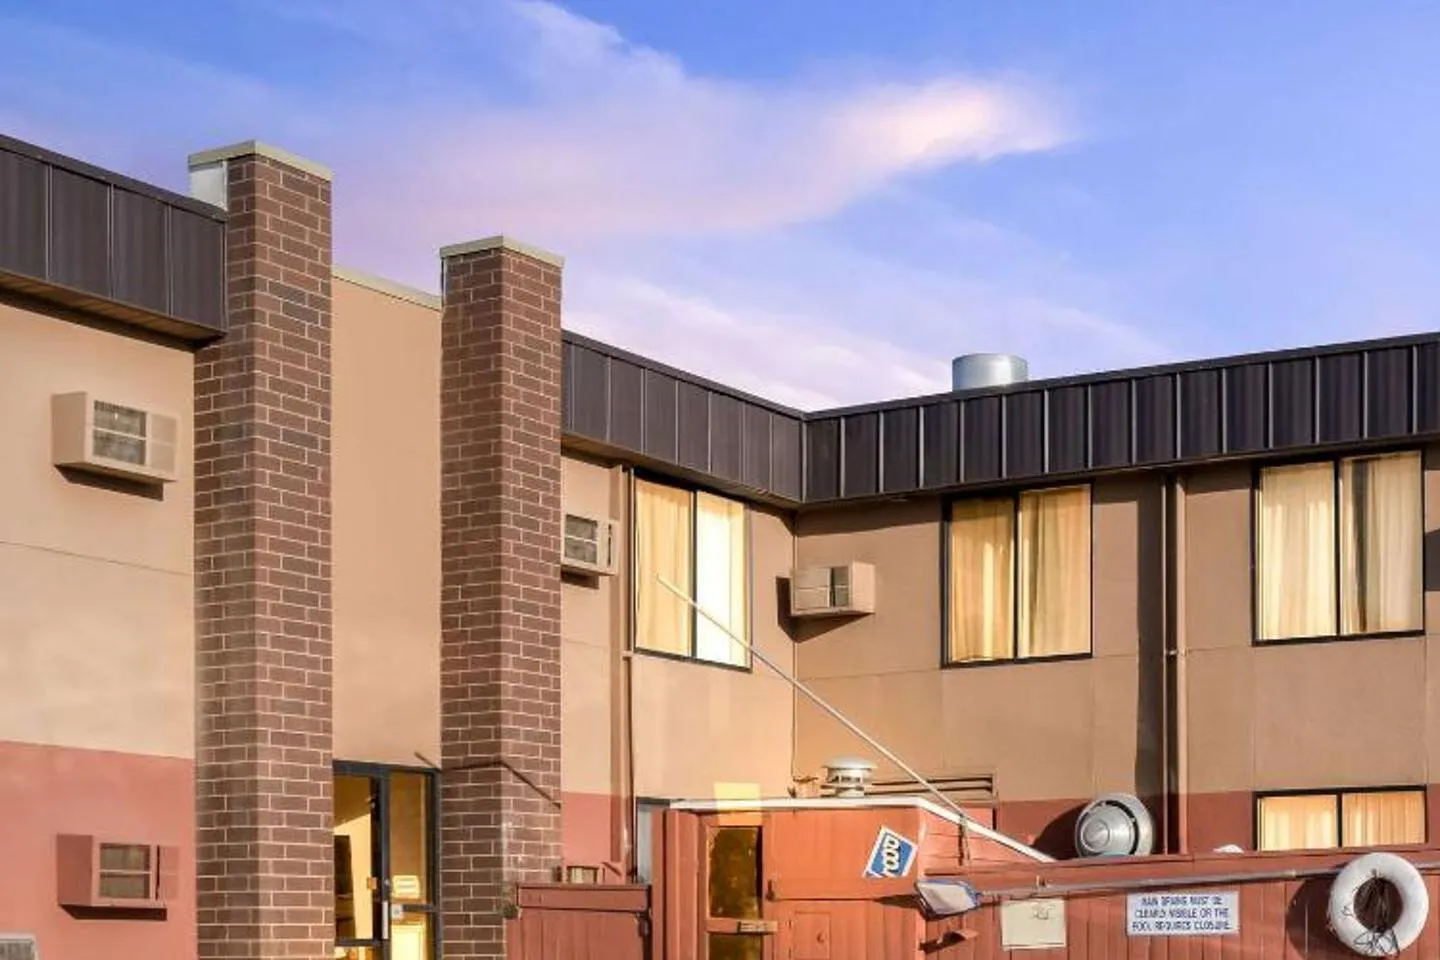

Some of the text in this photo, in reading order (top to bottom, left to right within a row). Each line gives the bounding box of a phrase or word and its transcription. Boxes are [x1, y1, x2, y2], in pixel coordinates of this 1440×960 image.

[1189, 896, 1209, 905] MUST
[1169, 909, 1197, 918] VISIBLE
[1200, 908, 1212, 918] OR
[1214, 908, 1230, 918] THE
[1132, 921, 1152, 932] POOL
